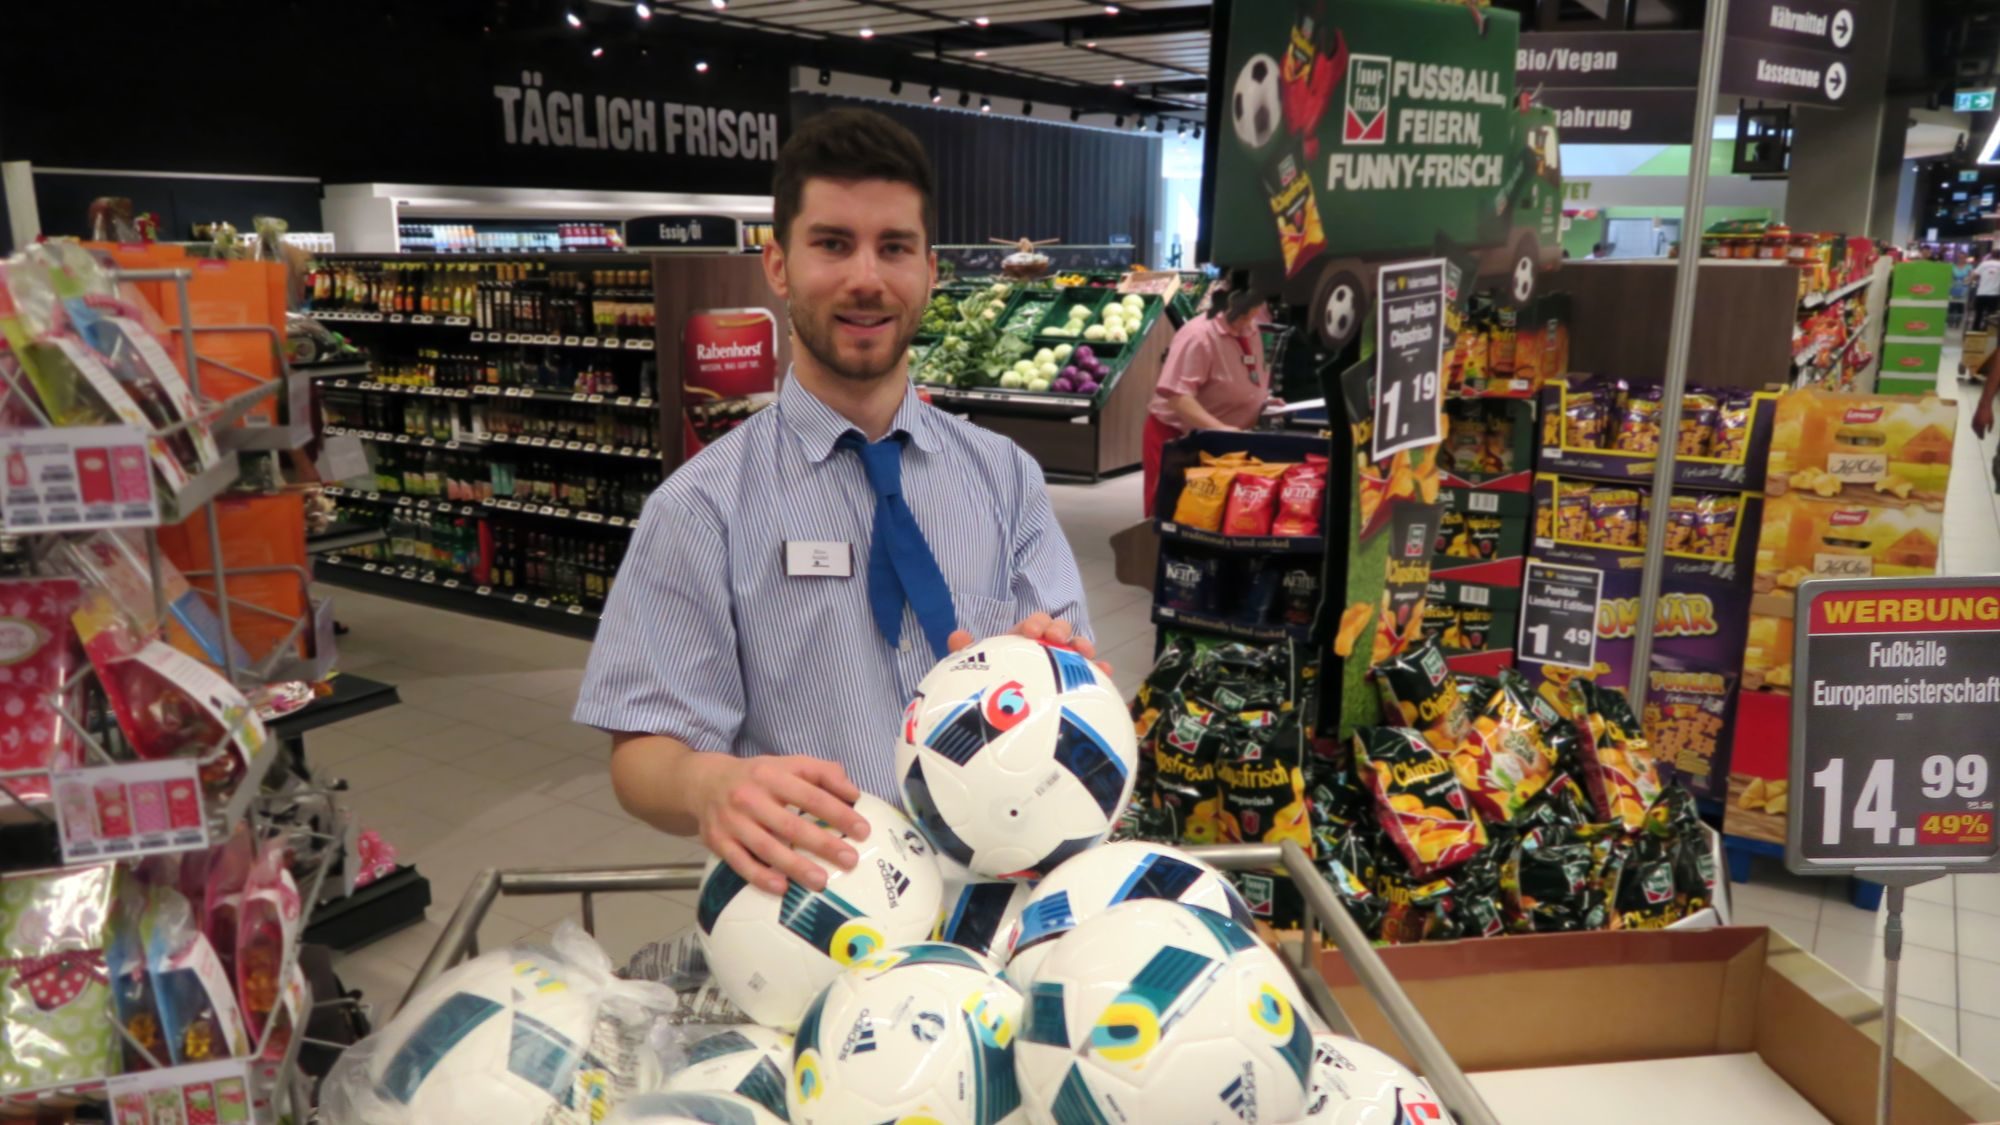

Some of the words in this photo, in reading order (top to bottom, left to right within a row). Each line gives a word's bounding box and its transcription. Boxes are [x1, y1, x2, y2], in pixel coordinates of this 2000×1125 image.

[1770, 6, 1827, 36] Nährmittel
[1516, 48, 1618, 72] Bio/Vegan
[1757, 59, 1821, 89] Kassenzone
[1392, 60, 1507, 108] FUSSBALL,
[494, 70, 656, 153] TÄGLICH
[665, 102, 778, 161] FRISCH
[1398, 108, 1482, 148] FEIERN,
[1554, 107, 1632, 131] nahrung
[658, 221, 702, 242] Essig/Öl
[696, 340, 763, 361] Rabenhorst
[1823, 597, 1999, 624] WERBUNG
[1869, 640, 1947, 669] Fußbälle
[1812, 676, 2000, 711] Europameisterschaft
[1922, 814, 1990, 835] 49%
[876, 858, 899, 909] adidas
